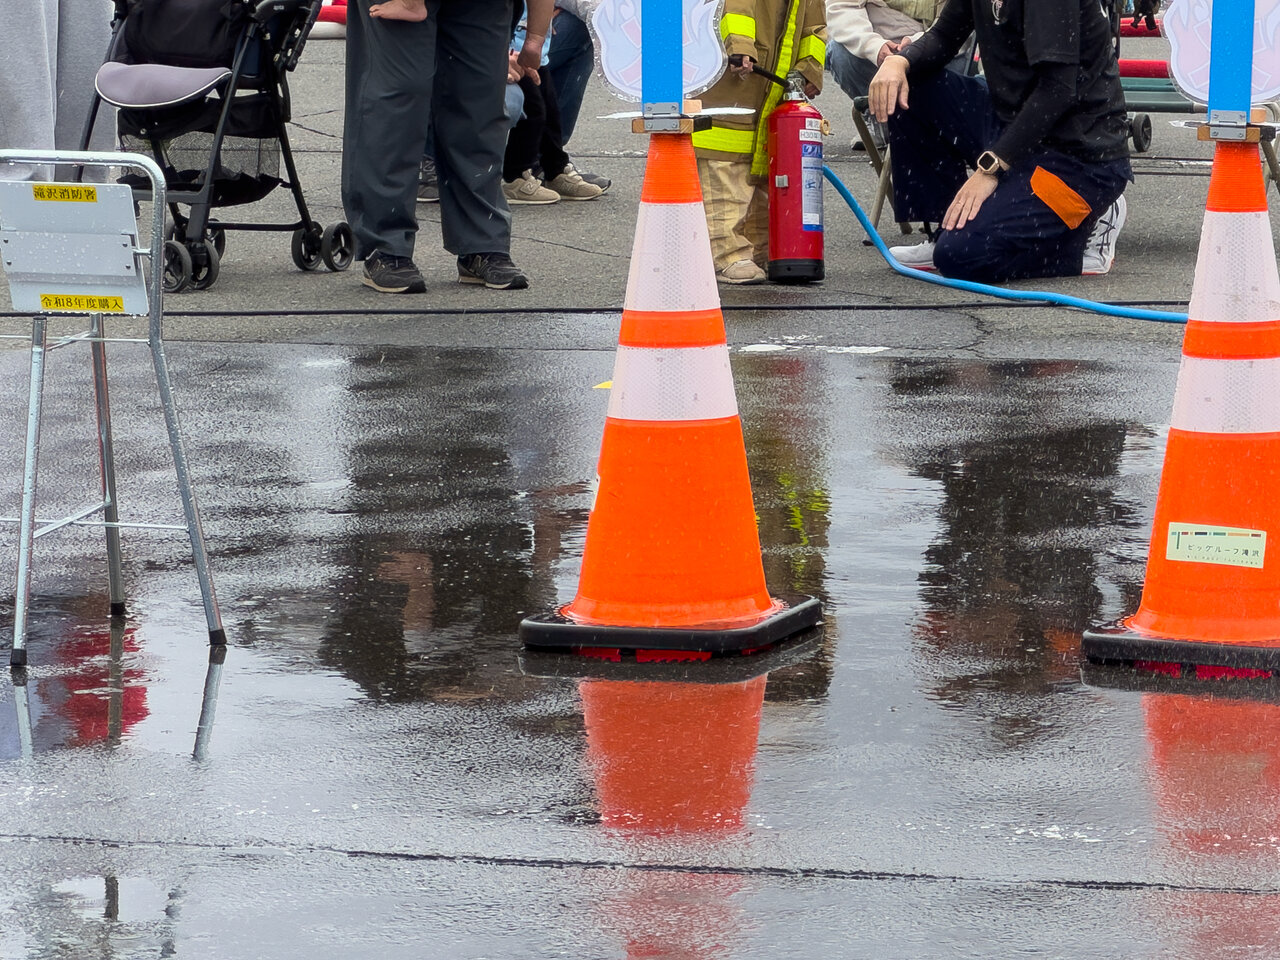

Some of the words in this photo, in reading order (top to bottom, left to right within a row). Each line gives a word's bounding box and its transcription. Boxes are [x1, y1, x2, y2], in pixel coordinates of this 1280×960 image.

[41, 296, 122, 309] 令和8年度購入
[1187, 544, 1259, 557] ビッグルーフ滝沢
